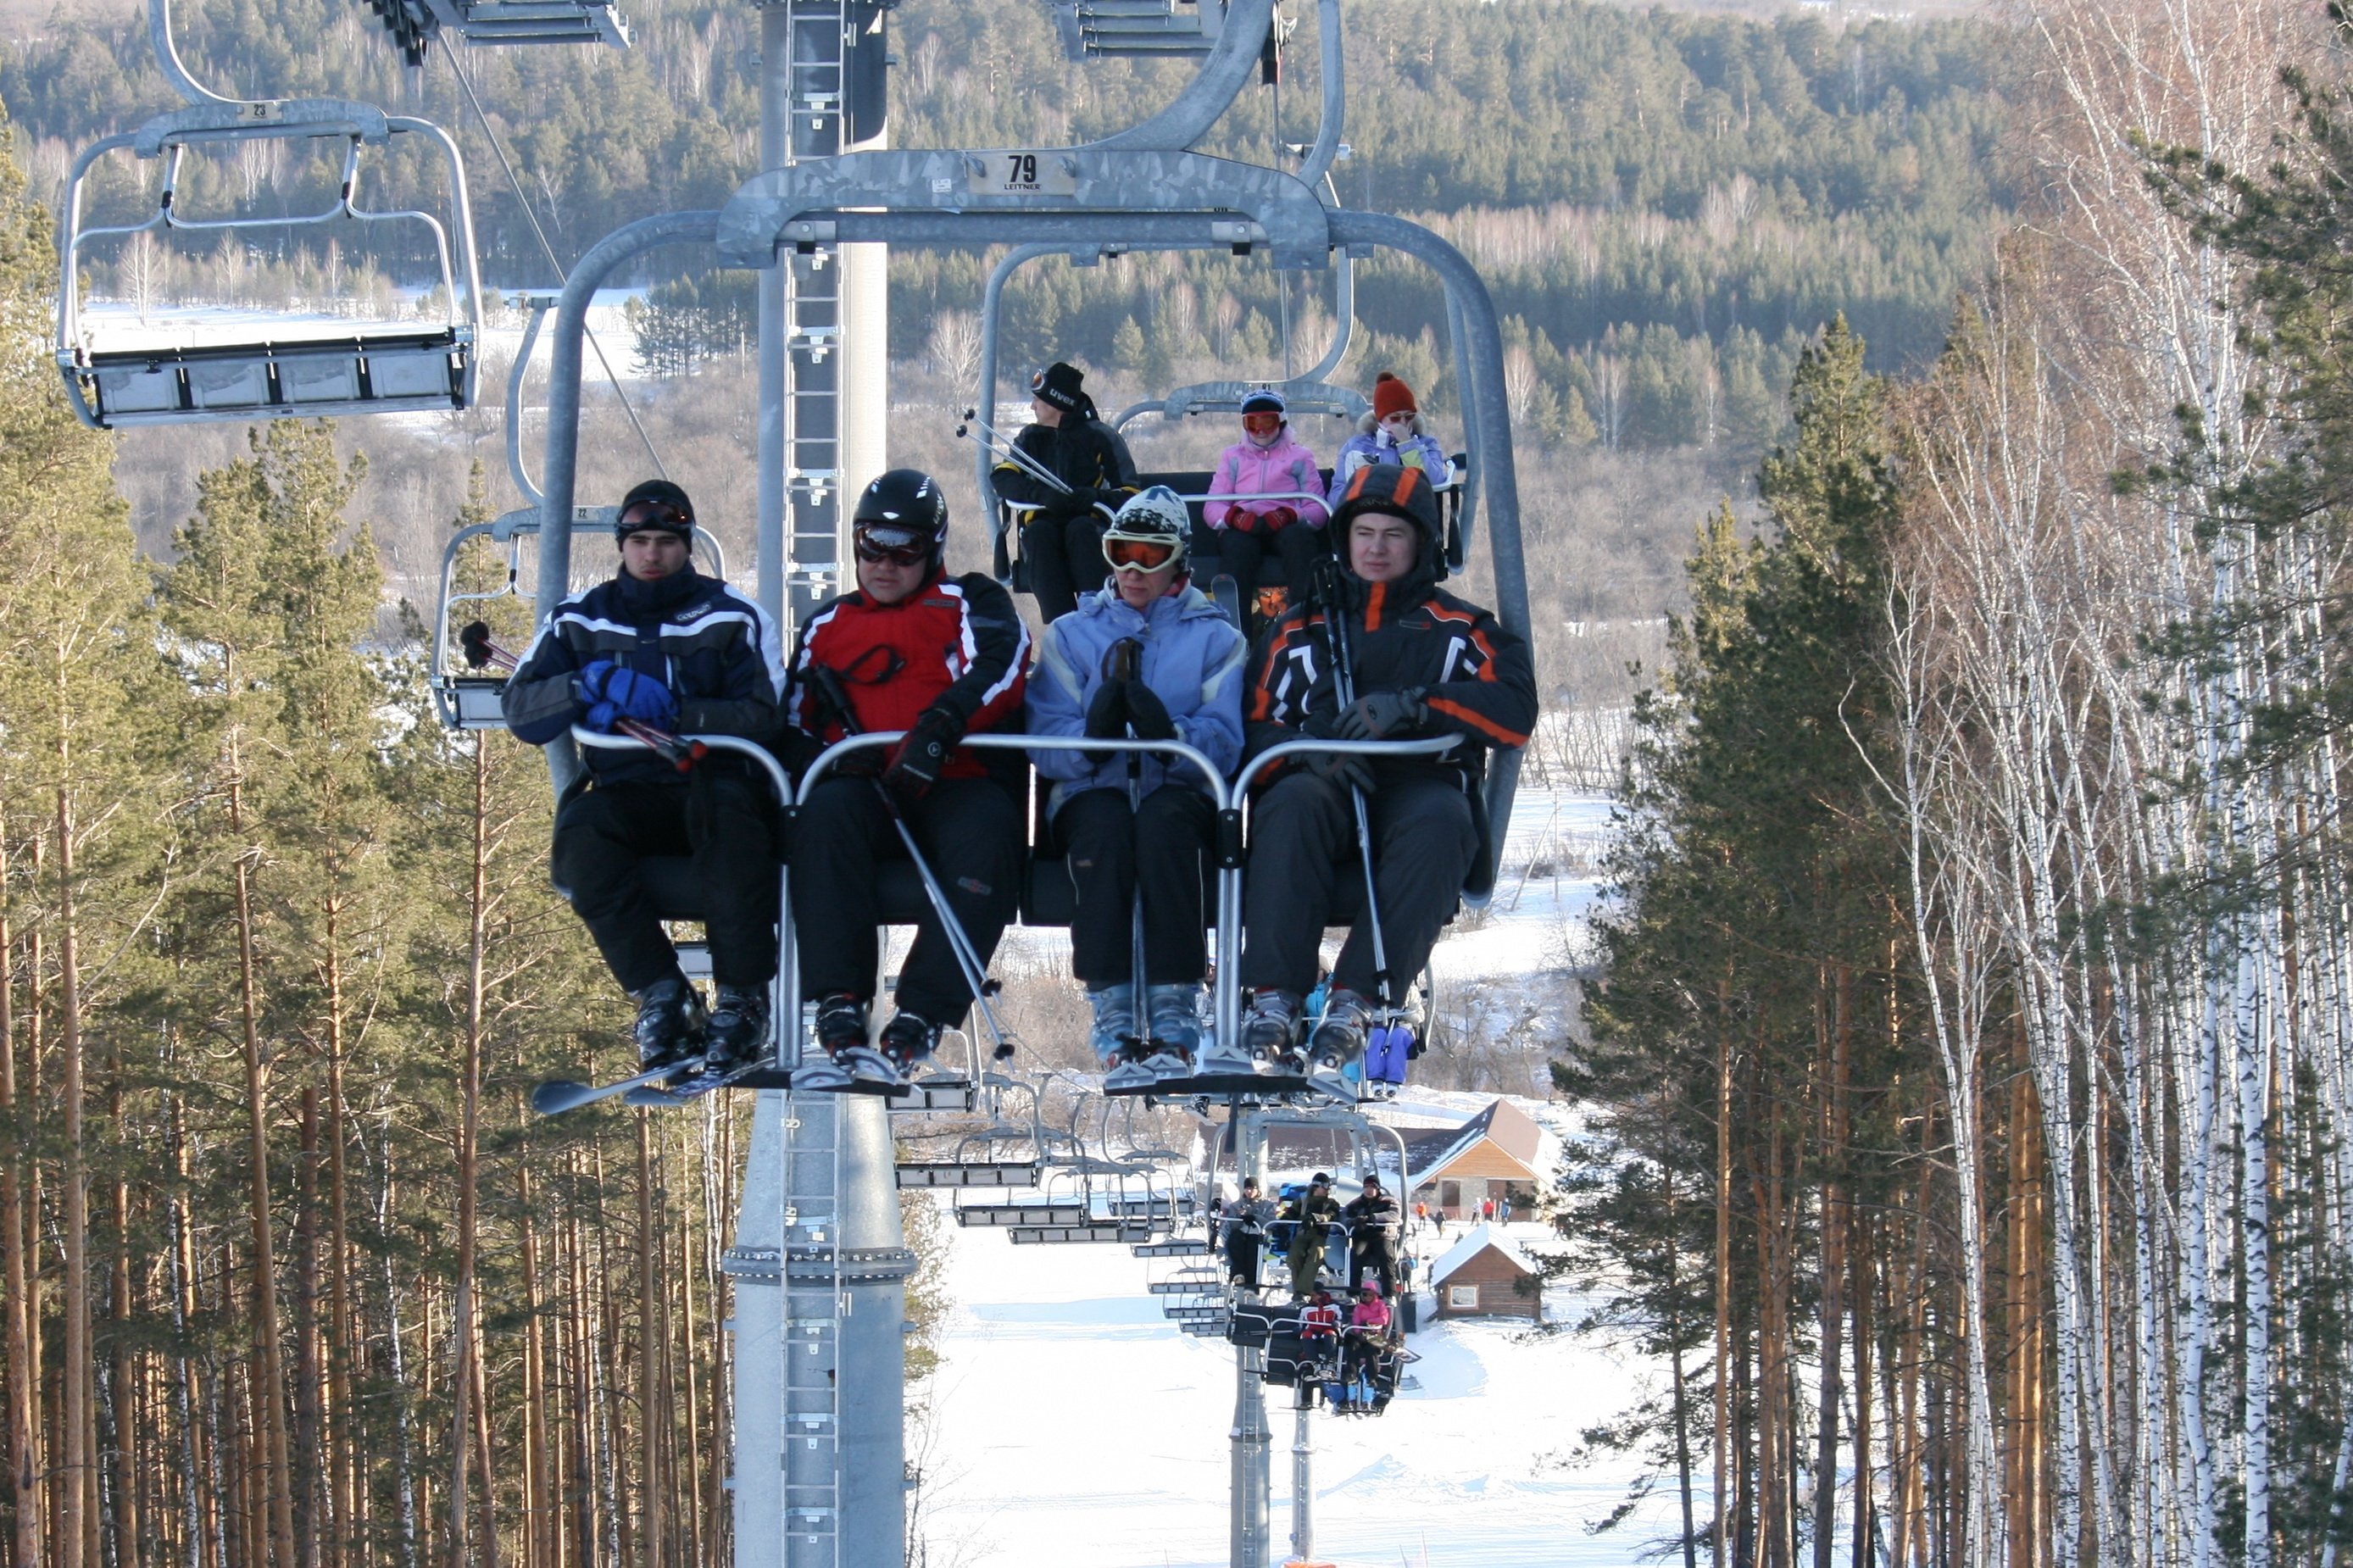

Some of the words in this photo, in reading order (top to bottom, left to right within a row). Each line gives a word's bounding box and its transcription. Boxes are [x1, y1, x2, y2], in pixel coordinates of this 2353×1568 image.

[254, 103, 266, 115] 23
[1009, 154, 1036, 182] 79
[1049, 388, 1076, 407] uvex
[577, 508, 587, 517] 22
